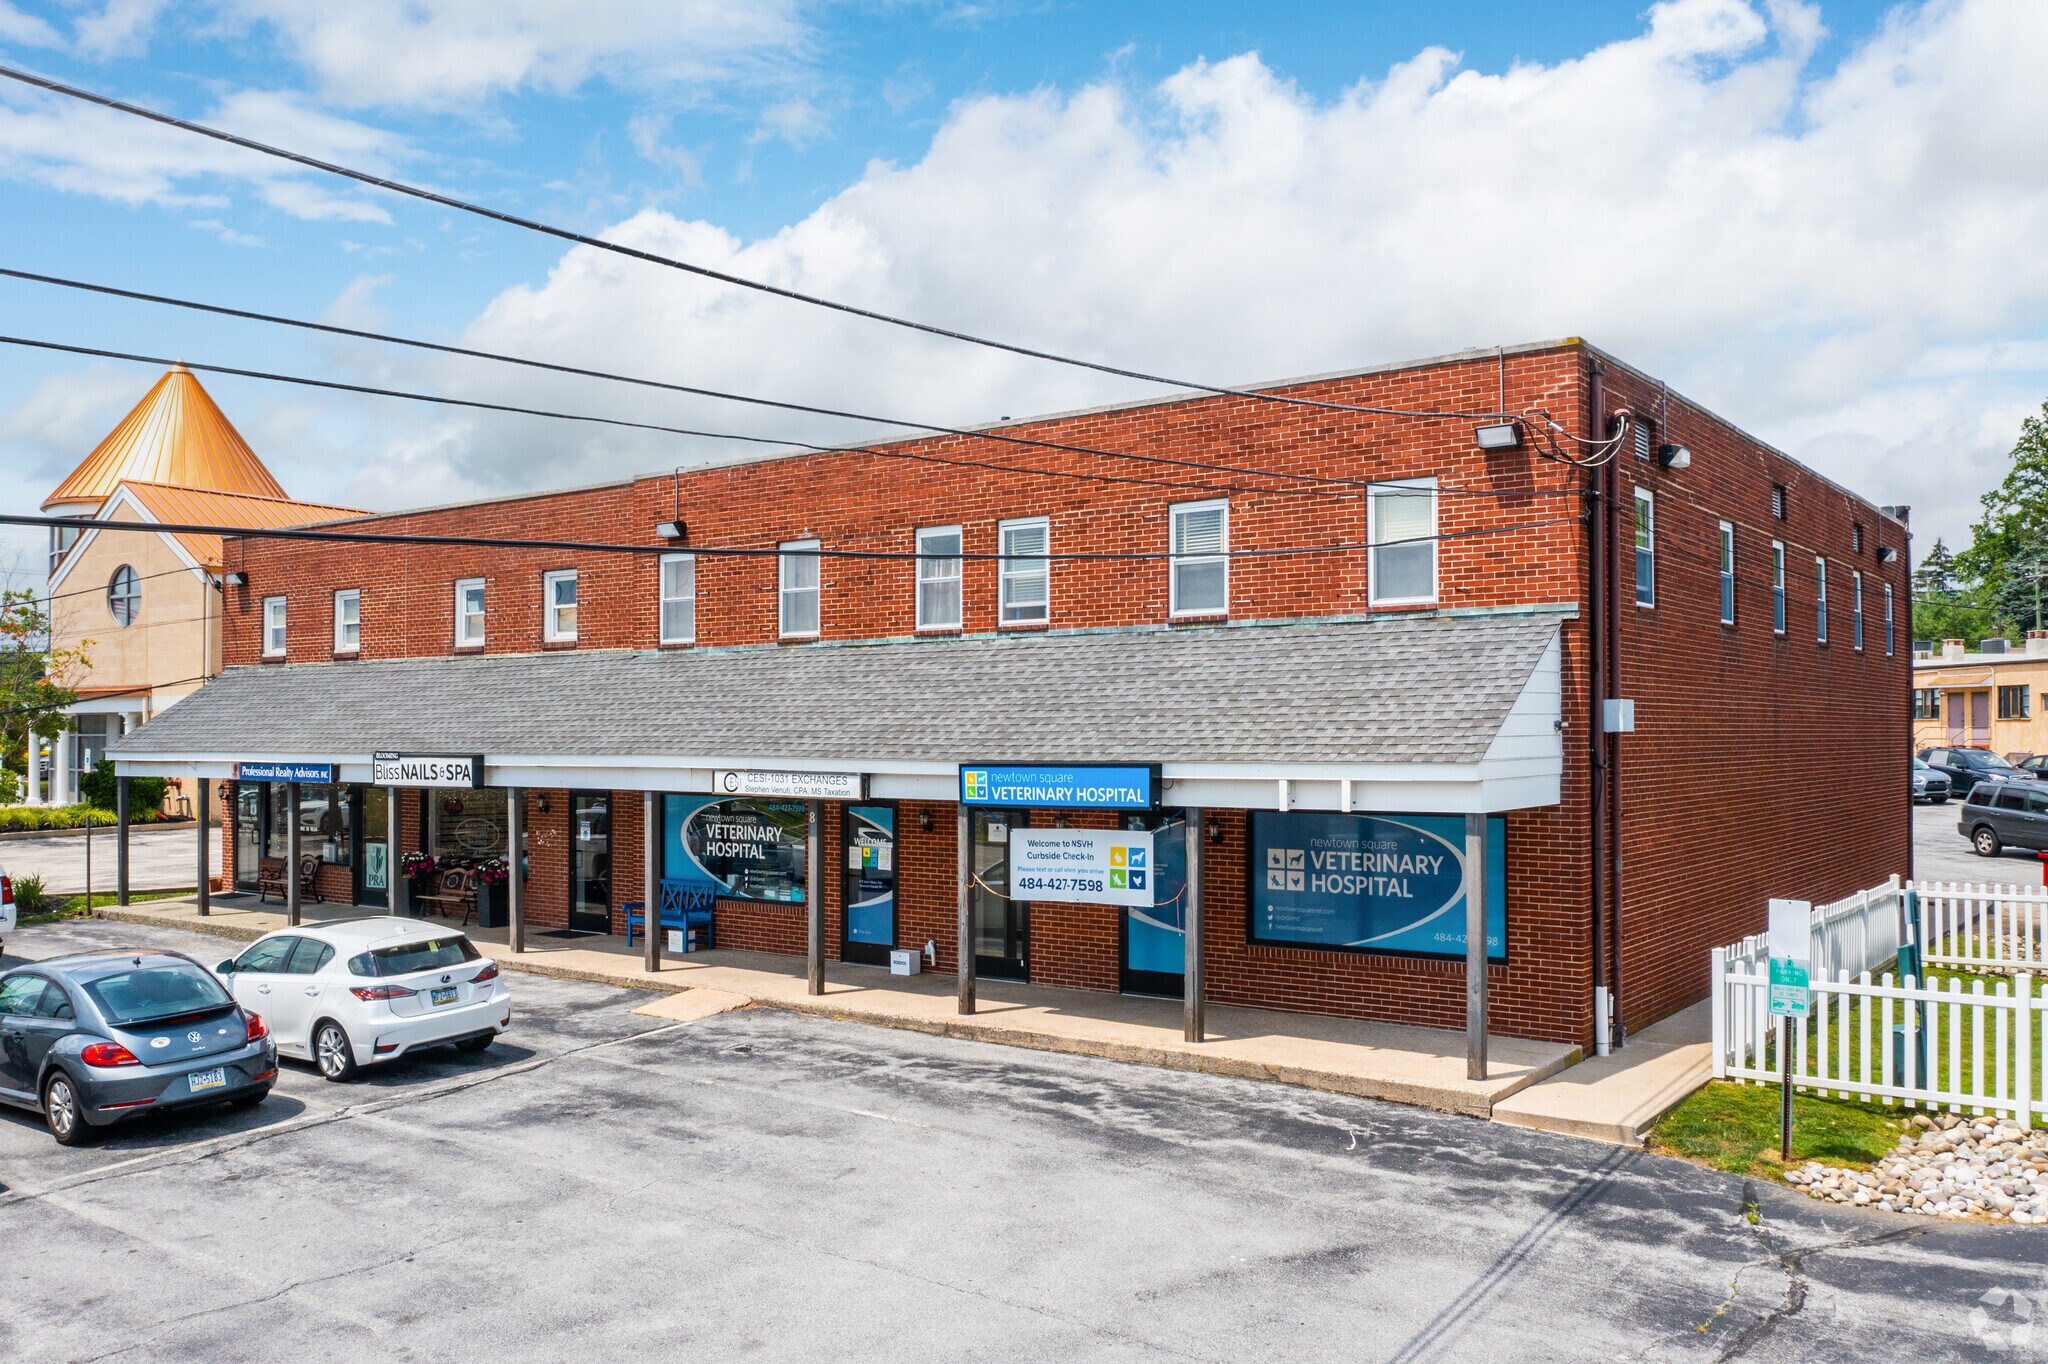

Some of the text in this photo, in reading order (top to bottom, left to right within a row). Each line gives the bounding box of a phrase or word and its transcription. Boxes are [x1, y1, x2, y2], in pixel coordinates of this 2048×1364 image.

[242, 766, 274, 777] Professional
[275, 767, 294, 780] Realty
[376, 764, 471, 781] Bliss NAILS & SPA
[747, 773, 848, 786] CESI-1031 EXCHANGES
[992, 773, 1073, 786] newtown square
[745, 785, 769, 794] Stephen
[811, 788, 822, 796] MS
[824, 788, 850, 797] Taxation
[992, 787, 1144, 803] VETERINARY HOSPITAL
[769, 804, 805, 813] 484-427-7598
[705, 814, 757, 825] newtown square
[809, 812, 815, 823] 8
[706, 824, 782, 842] VETERINARY
[854, 838, 887, 846] WELCOME
[1027, 840, 1060, 848] Welcome
[1071, 840, 1093, 849] NSVH
[1310, 837, 1397, 851] newtown square
[707, 842, 765, 860] HOSPITAL
[1027, 852, 1094, 861] Curbside Check-In
[1310, 851, 1443, 875] VETERINARY
[368, 875, 384, 887] PRA
[1019, 877, 1103, 892] 484-427-7598
[1311, 874, 1413, 898] HOSPITAL
[1781, 976, 1797, 984] ONLY
